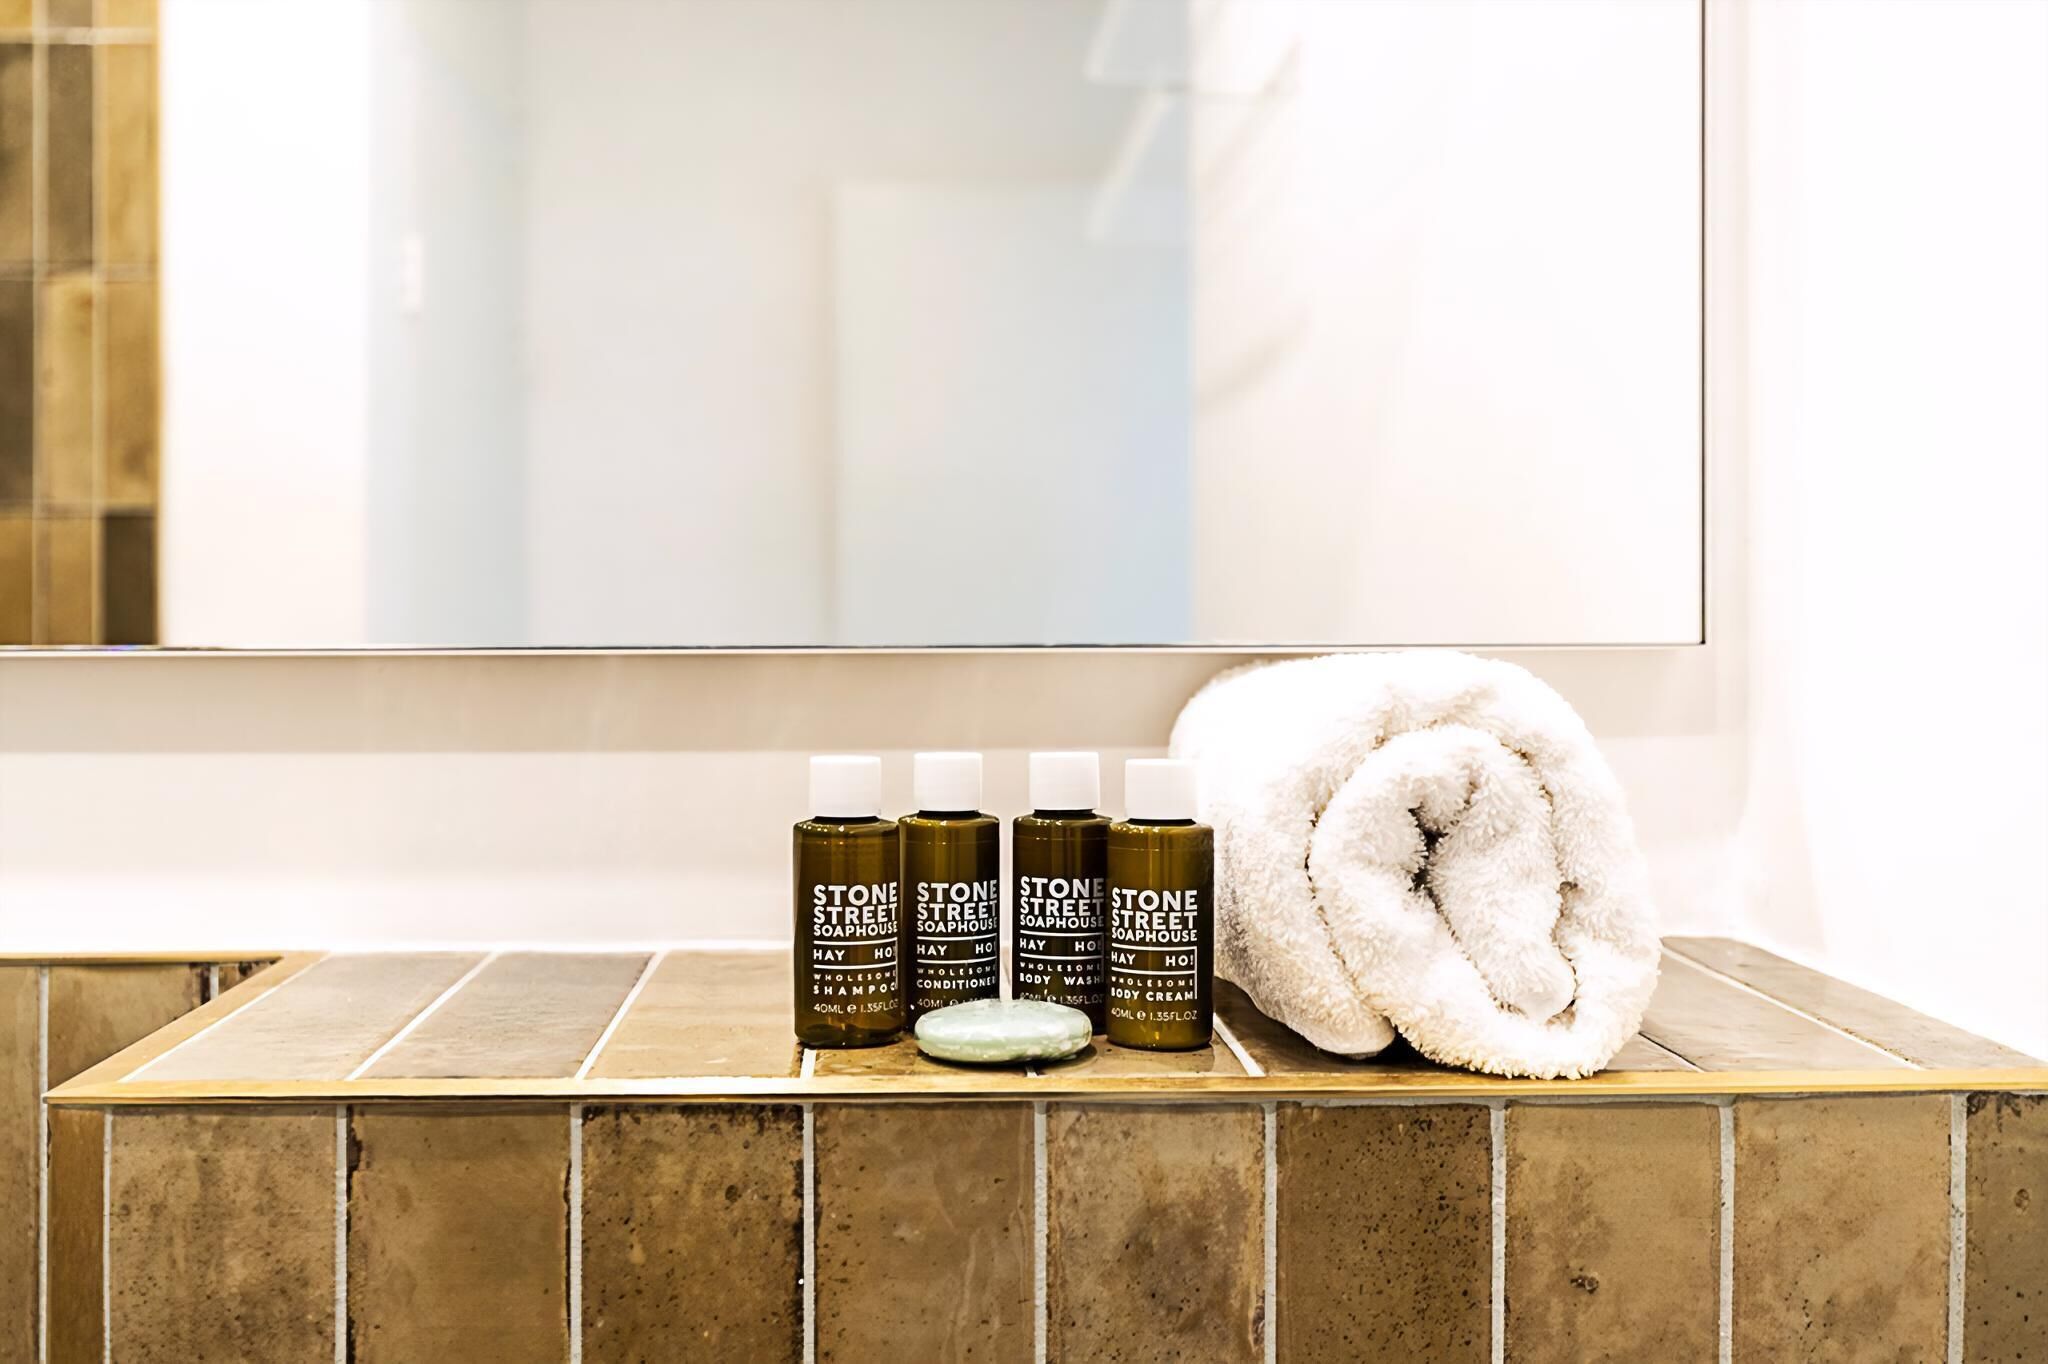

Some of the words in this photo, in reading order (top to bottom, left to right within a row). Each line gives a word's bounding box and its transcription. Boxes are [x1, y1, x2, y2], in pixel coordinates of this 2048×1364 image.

[813, 881, 897, 906] STONE
[917, 879, 997, 903] STONE
[1020, 875, 1104, 899] STONE
[1020, 896, 1104, 917] STREET
[1111, 887, 1198, 912] STONE
[813, 903, 897, 925] STREET
[917, 900, 997, 921] STREET
[917, 917, 997, 933] SOAPHOUSE
[1020, 914, 1104, 929] SOAPHOUSE
[1111, 909, 1198, 930] STREET
[813, 921, 897, 937] SOAPHOUSE
[1111, 926, 1198, 943] SOAPHOUSE
[917, 944, 947, 956] HAY
[1020, 938, 1046, 951] HAY
[813, 949, 845, 961] HAY
[1111, 952, 1136, 965] HAY
[1165, 954, 1194, 967] HO!
[916, 975, 996, 990] CONDITIONER
[1020, 973, 1051, 985] BODY
[1064, 975, 1100, 986] WASH
[1111, 987, 1140, 1000] BODY
[1145, 991, 1194, 1002] CREAM
[813, 1003, 844, 1014] 40ML
